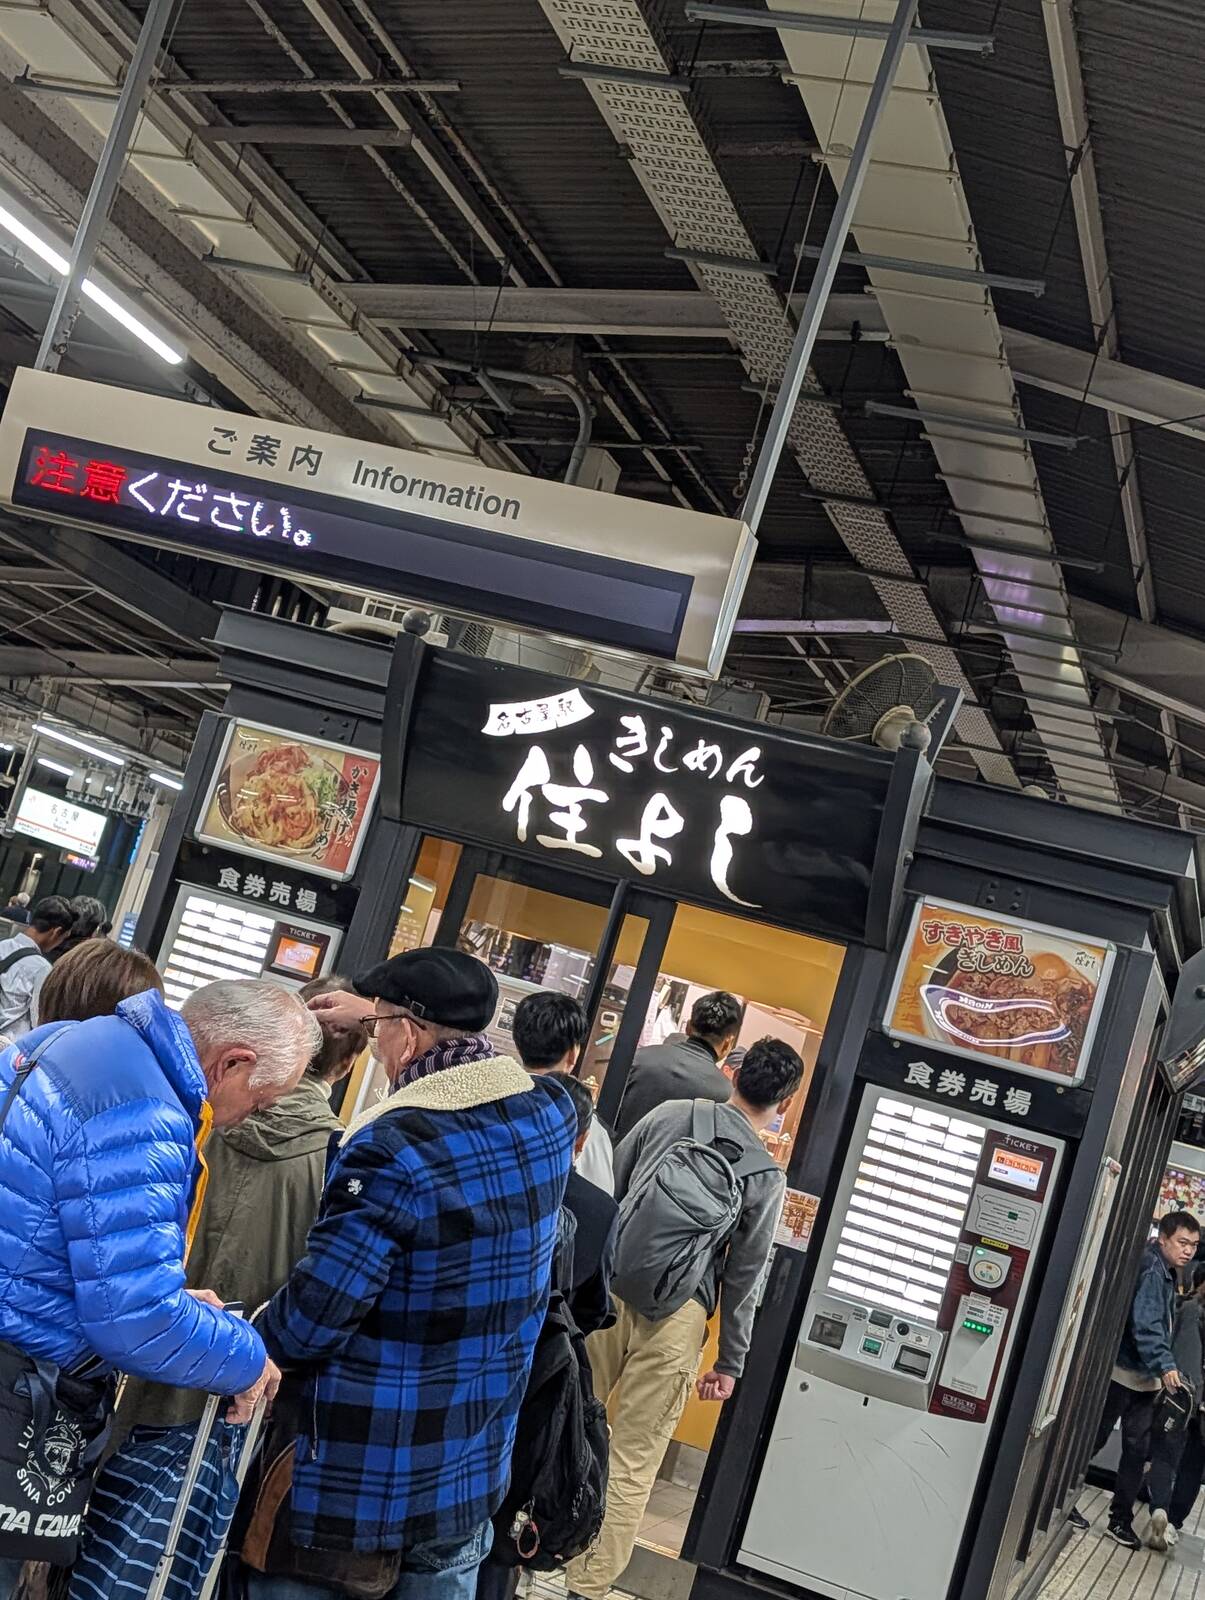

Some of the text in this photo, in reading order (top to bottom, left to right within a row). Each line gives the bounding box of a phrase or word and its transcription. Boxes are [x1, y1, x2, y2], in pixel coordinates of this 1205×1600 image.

[207, 426, 521, 520] ご案内 Information
[29, 447, 312, 547] 注意ください。
[609, 714, 764, 788] きしめん
[502, 744, 763, 908] 住よし
[217, 867, 318, 914] 食券売場
[289, 927, 318, 940] TICKET
[923, 921, 1024, 953] すきやき風
[956, 948, 1035, 977] きしめん
[903, 1061, 1032, 1116] 食券売場
[1004, 1136, 1040, 1153] TICKET
[16, 1467, 41, 1504] SINA
